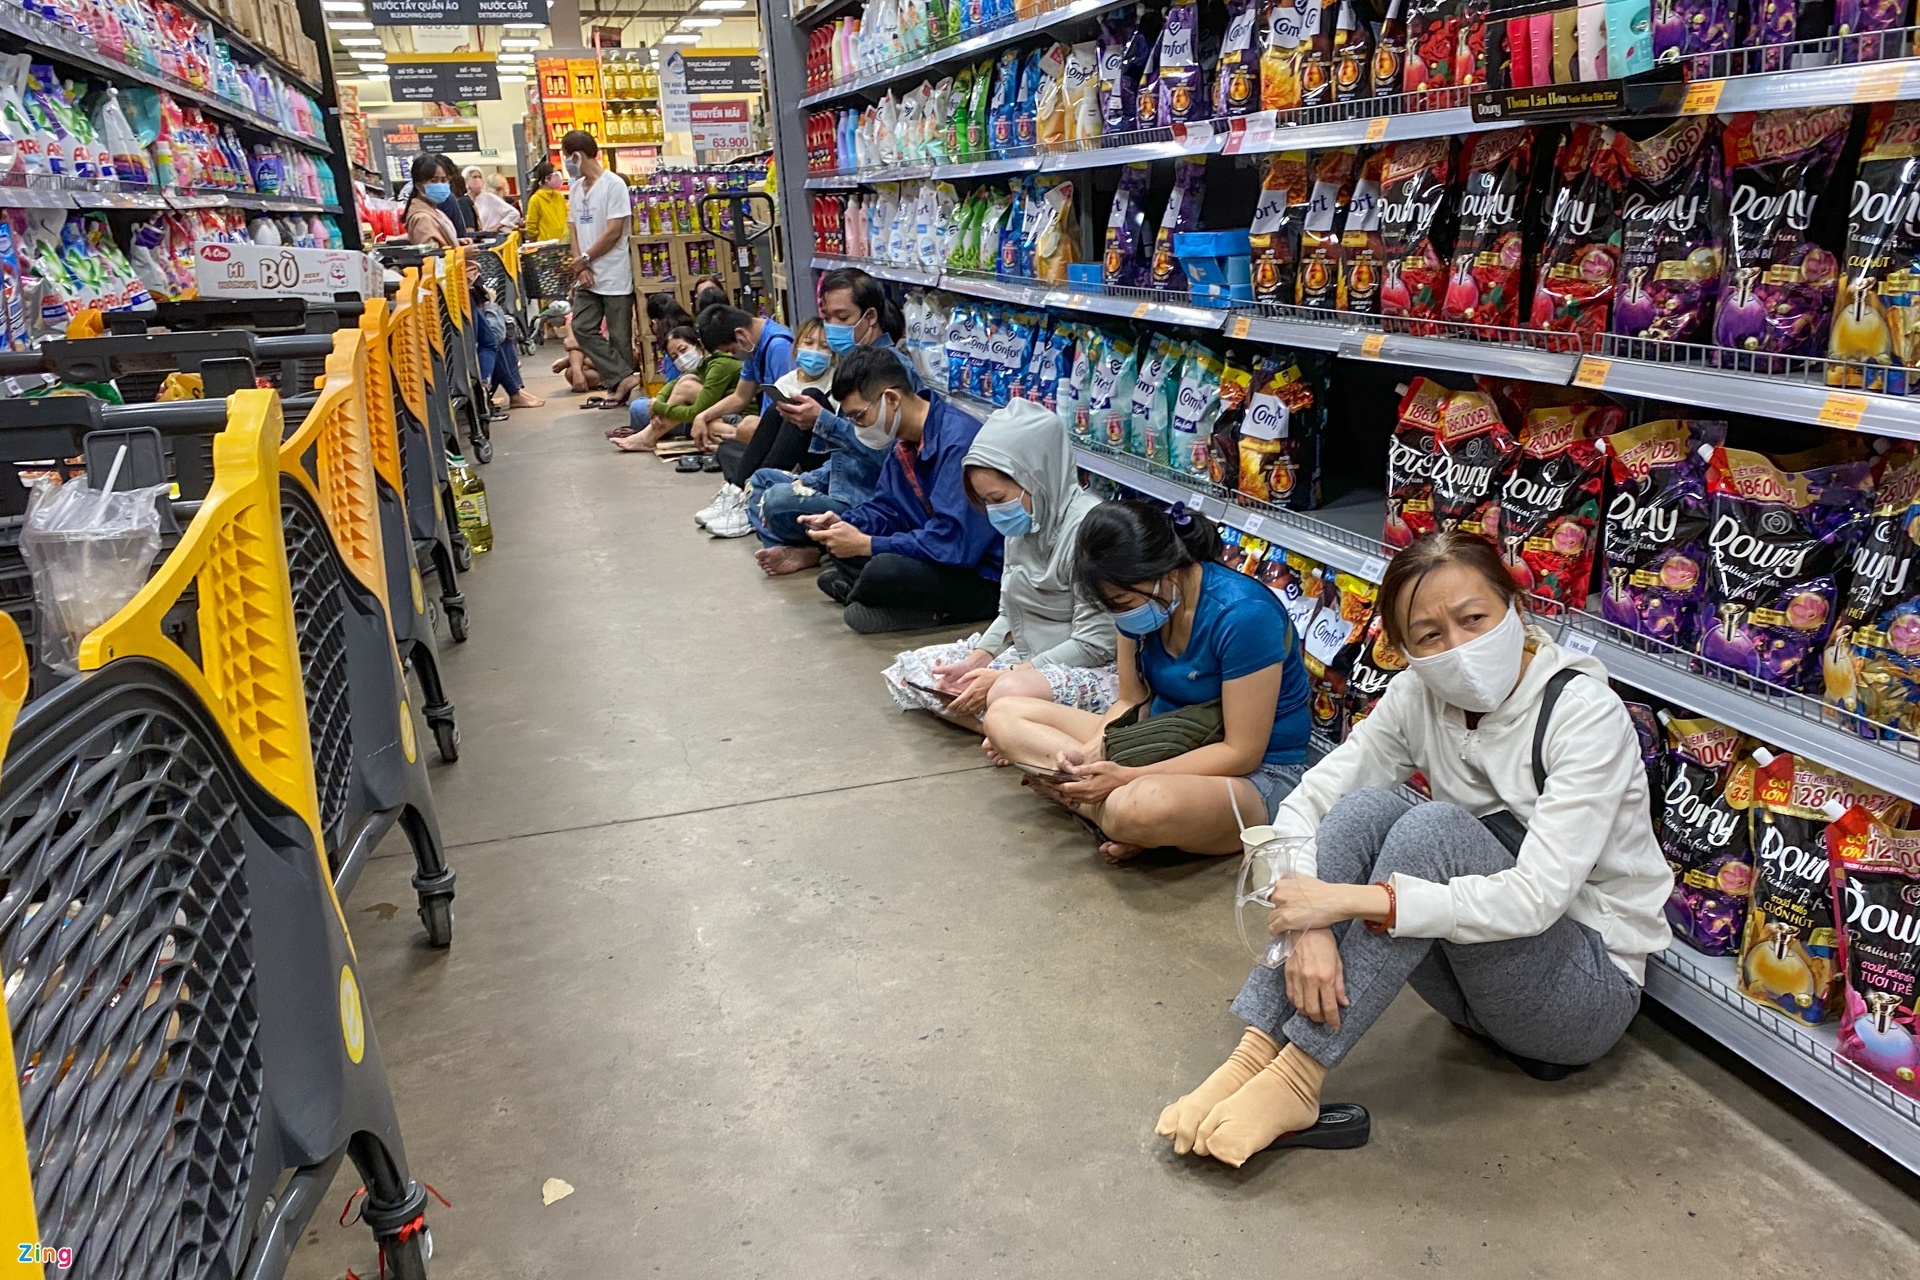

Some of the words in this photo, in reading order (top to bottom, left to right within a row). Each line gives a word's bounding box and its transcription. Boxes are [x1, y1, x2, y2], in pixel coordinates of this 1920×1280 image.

[692, 106, 723, 118] KHUYẾN
[724, 107, 740, 118] MÃI
[1478, 103, 1501, 116] Downy
[713, 137, 749, 147] 63.900
[227, 261, 244, 279] MÌ
[259, 250, 299, 289] BÒ
[1431, 454, 1493, 497] Downy
[1708, 514, 1808, 579] Downy
[1313, 619, 1347, 648] Comfort
[1706, 727, 1725, 741] ĐẾN
[1768, 778, 1791, 789] GÓI
[1794, 771, 1813, 784] TIẾT
[1762, 788, 1788, 803] LỚN
[1763, 901, 1790, 921] CUỐN
[1790, 913, 1815, 928] HÚT
[1848, 928, 1899, 962] Premium
[1860, 970, 1889, 989] TƯƠI
[1891, 981, 1914, 996] TRẺ
